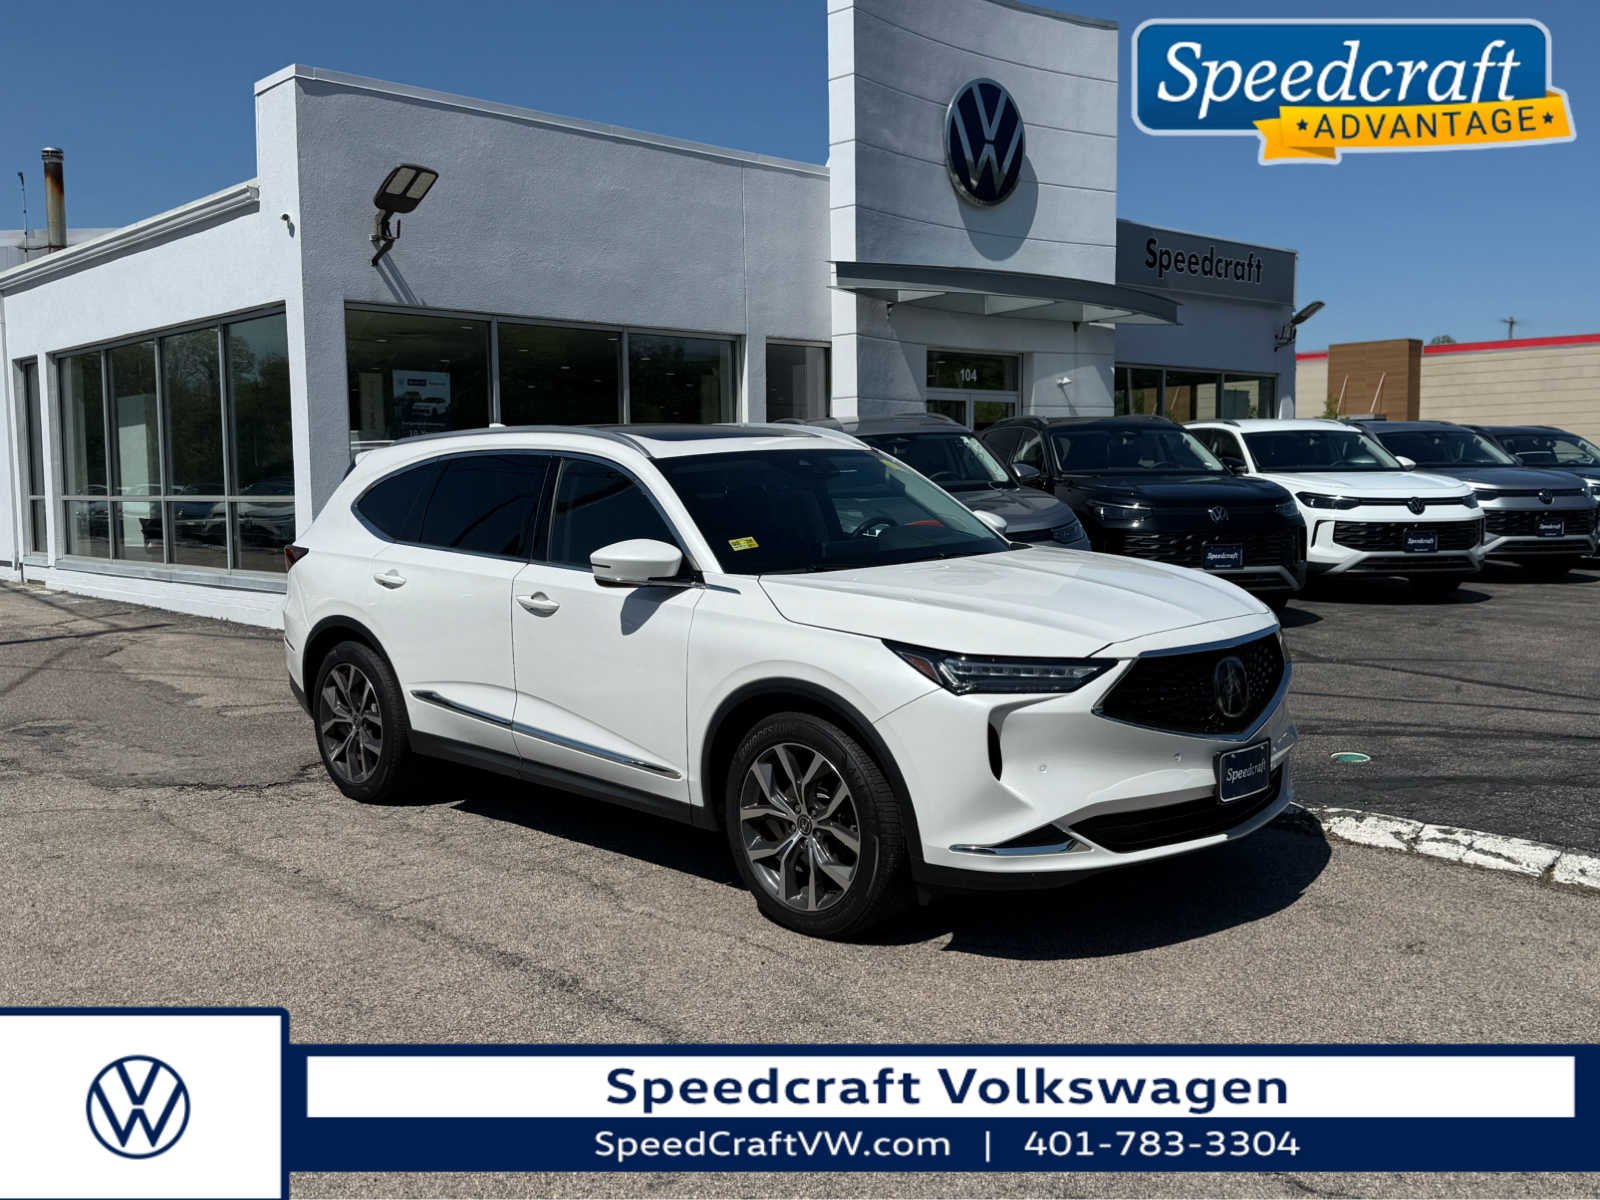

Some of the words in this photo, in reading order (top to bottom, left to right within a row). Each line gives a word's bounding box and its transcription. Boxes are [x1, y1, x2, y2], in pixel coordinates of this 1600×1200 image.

[1144, 237, 1263, 283] Speedcraft
[959, 368, 977, 382] 104
[1226, 758, 1266, 784] Speedcraft
